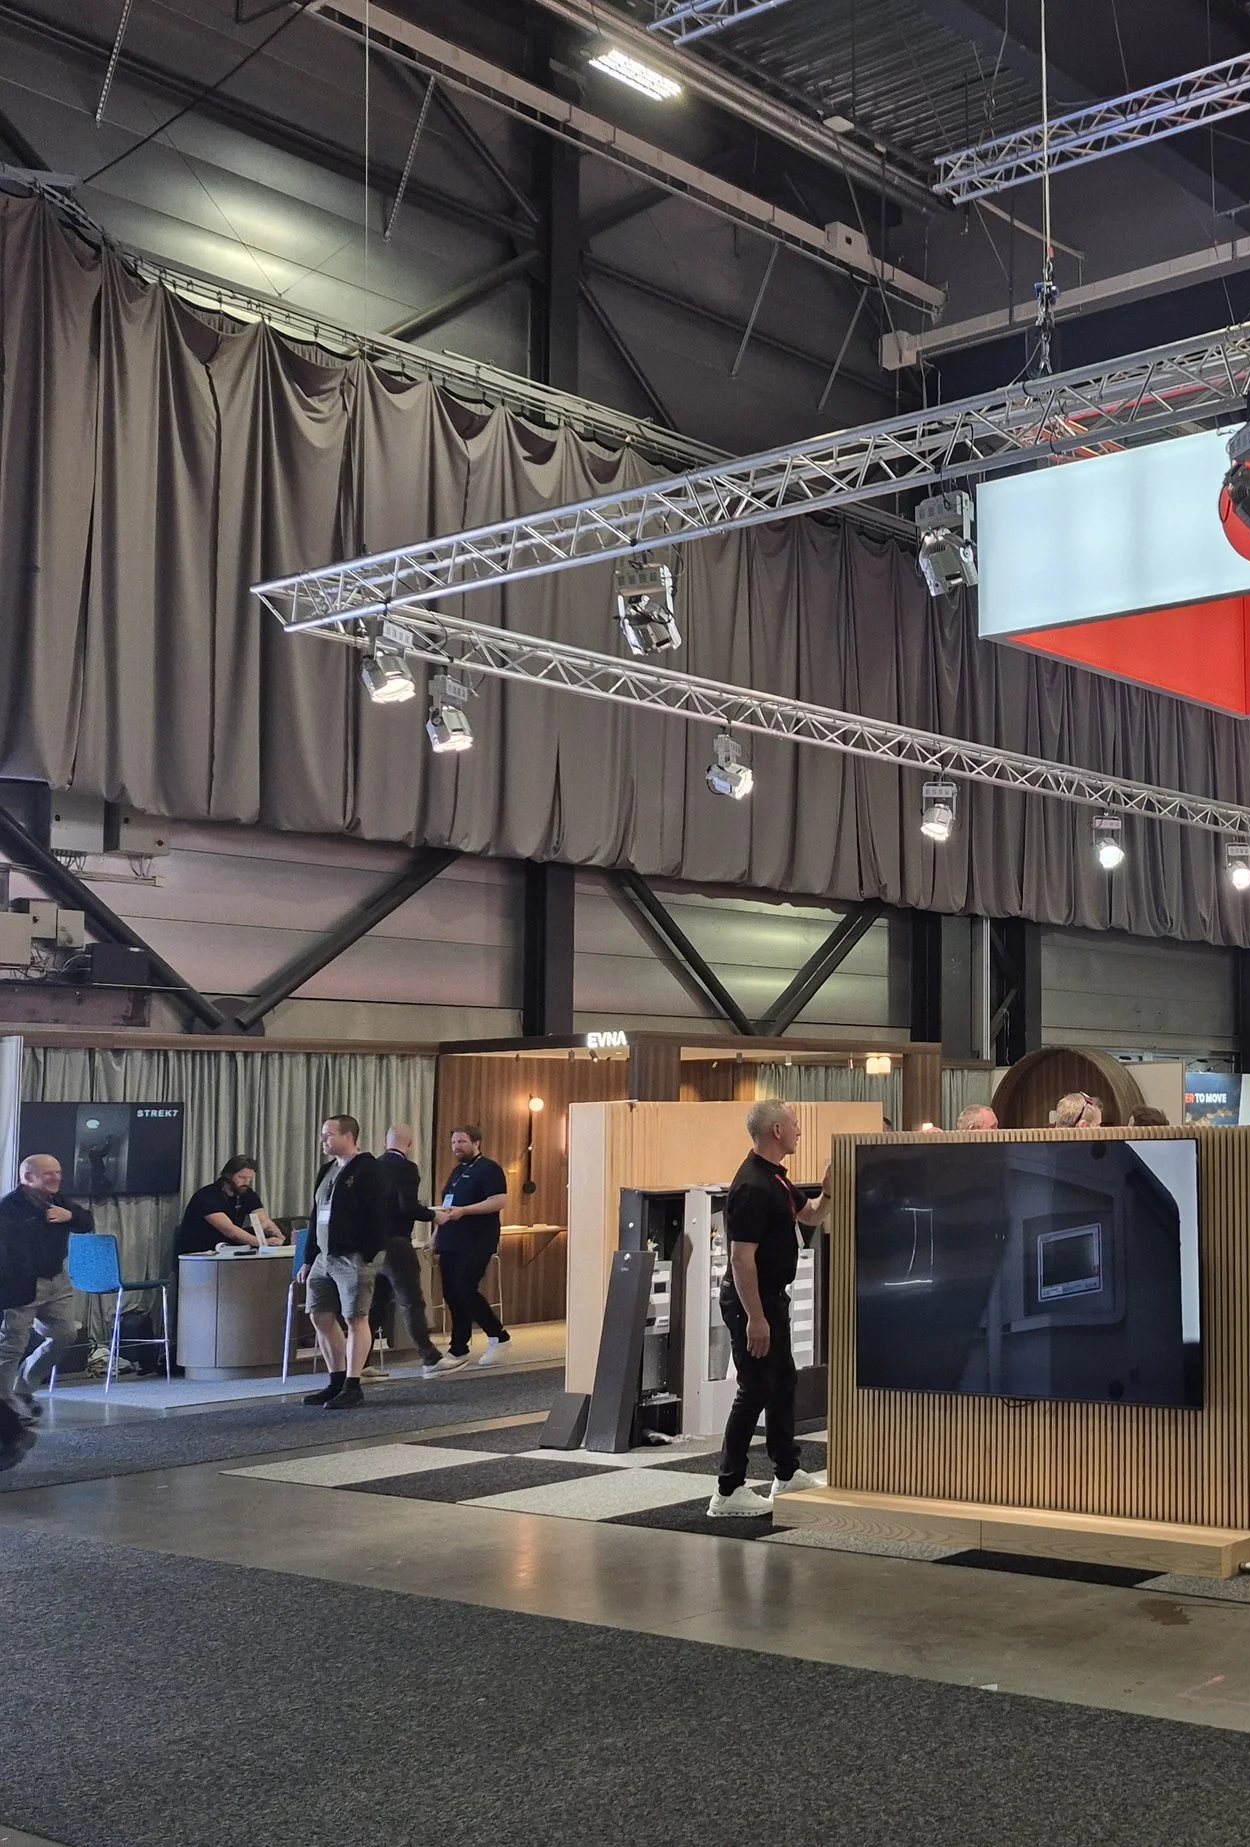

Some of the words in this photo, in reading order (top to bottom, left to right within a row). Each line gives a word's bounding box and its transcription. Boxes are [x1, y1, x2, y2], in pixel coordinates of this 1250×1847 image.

[1195, 1092, 1205, 1104] TO
[1205, 1092, 1227, 1104] MOVE
[137, 1109, 179, 1117] STREK7
